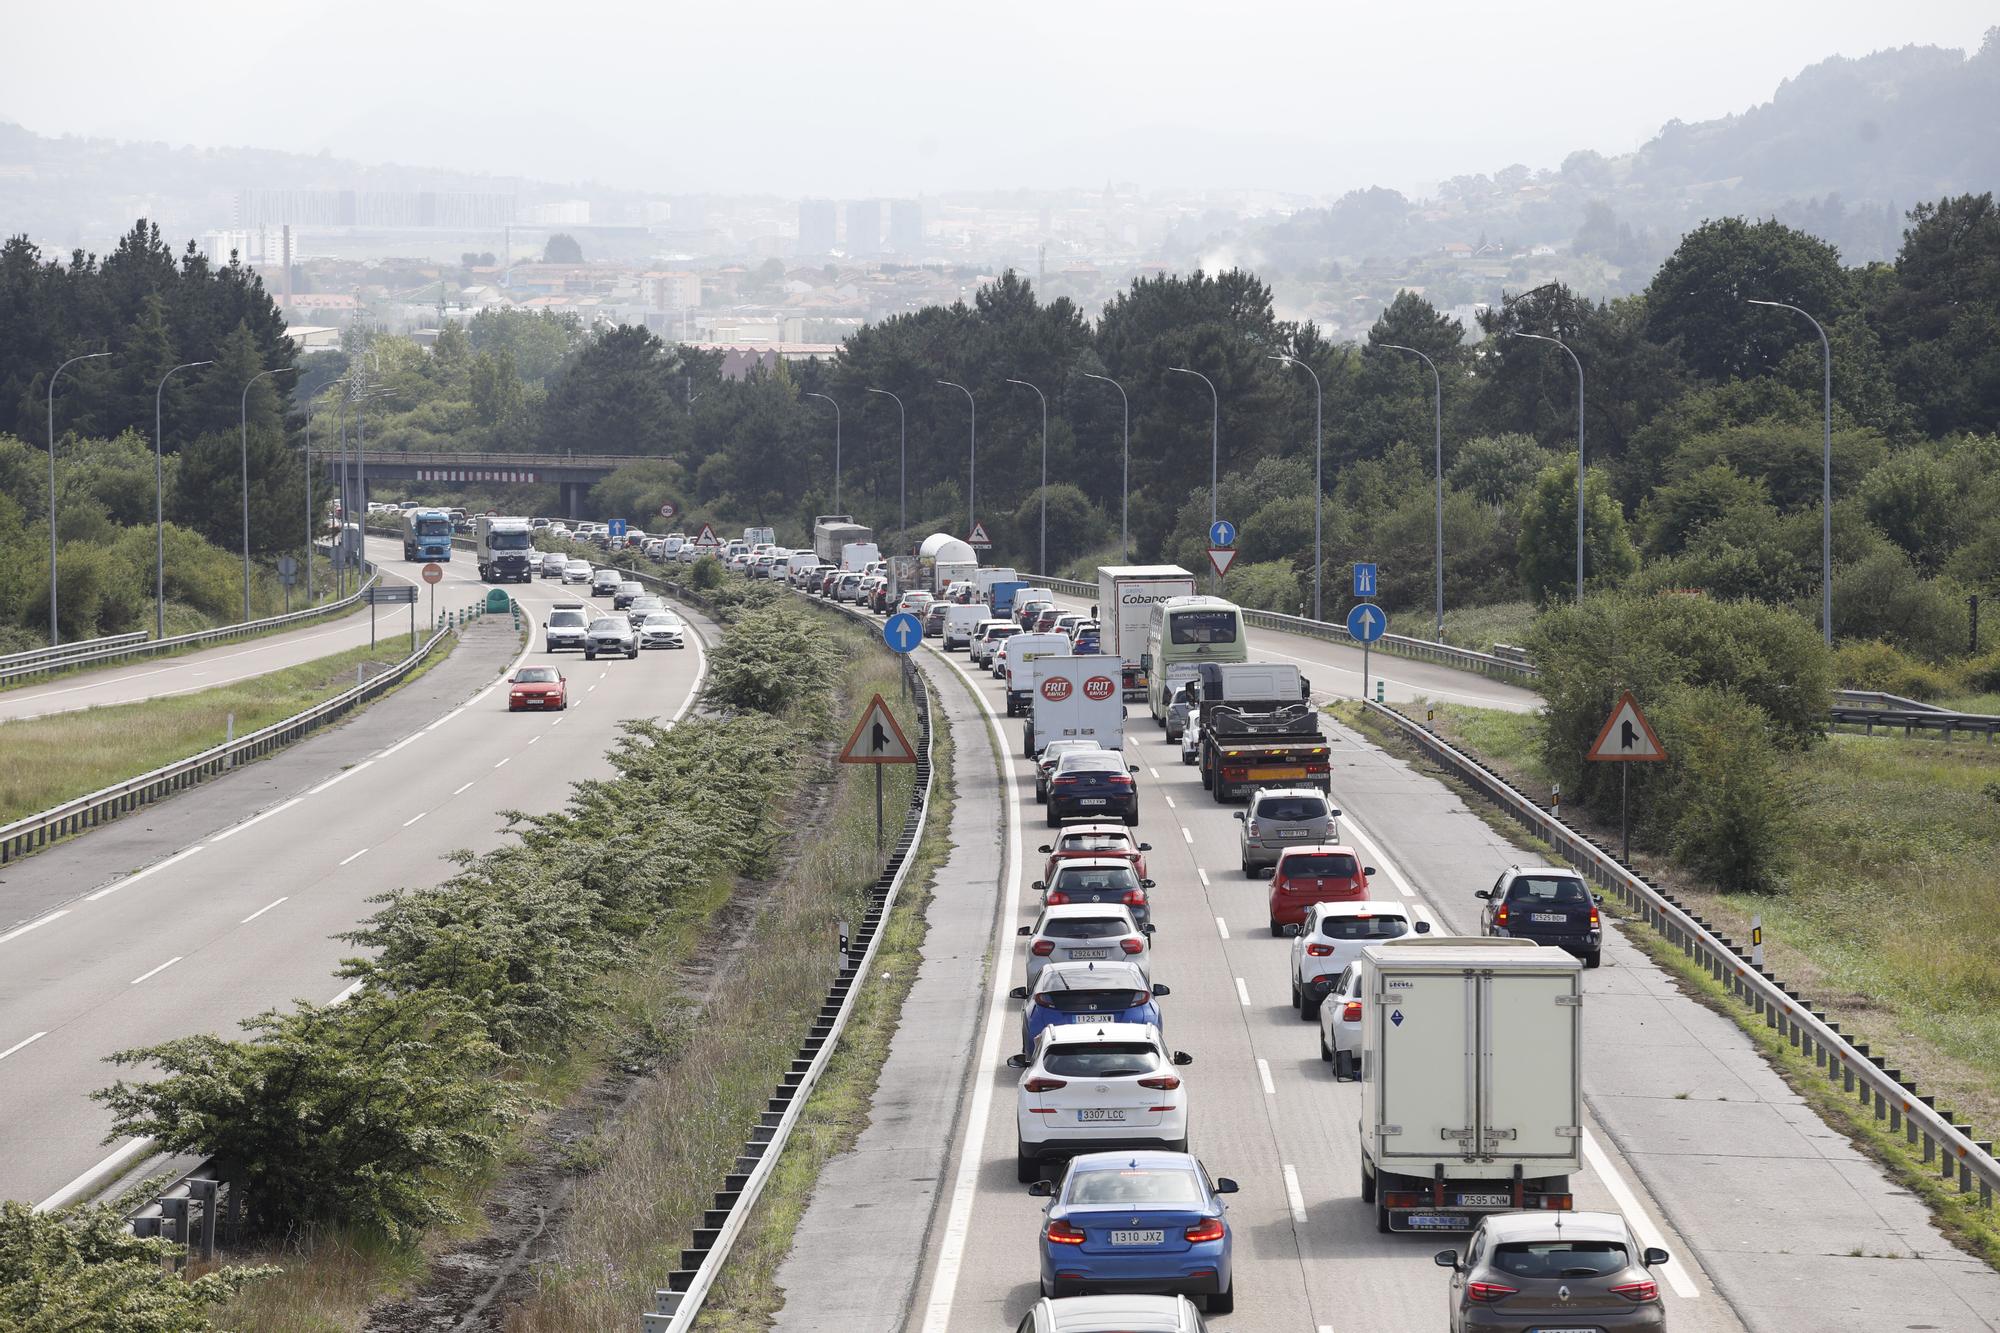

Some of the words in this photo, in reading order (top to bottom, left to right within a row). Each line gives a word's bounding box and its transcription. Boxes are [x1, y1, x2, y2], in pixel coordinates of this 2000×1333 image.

[1044, 682, 1068, 692] FRIT
[1086, 681, 1111, 691] FRIT
[1077, 1015, 1096, 1023] 1125
[1083, 1110, 1105, 1119] 3307
[1107, 1110, 1124, 1119] LCC
[1464, 1195, 1488, 1205] 7595
[1114, 1232, 1139, 1242] 1310
[1142, 1231, 1162, 1241] JXZ
